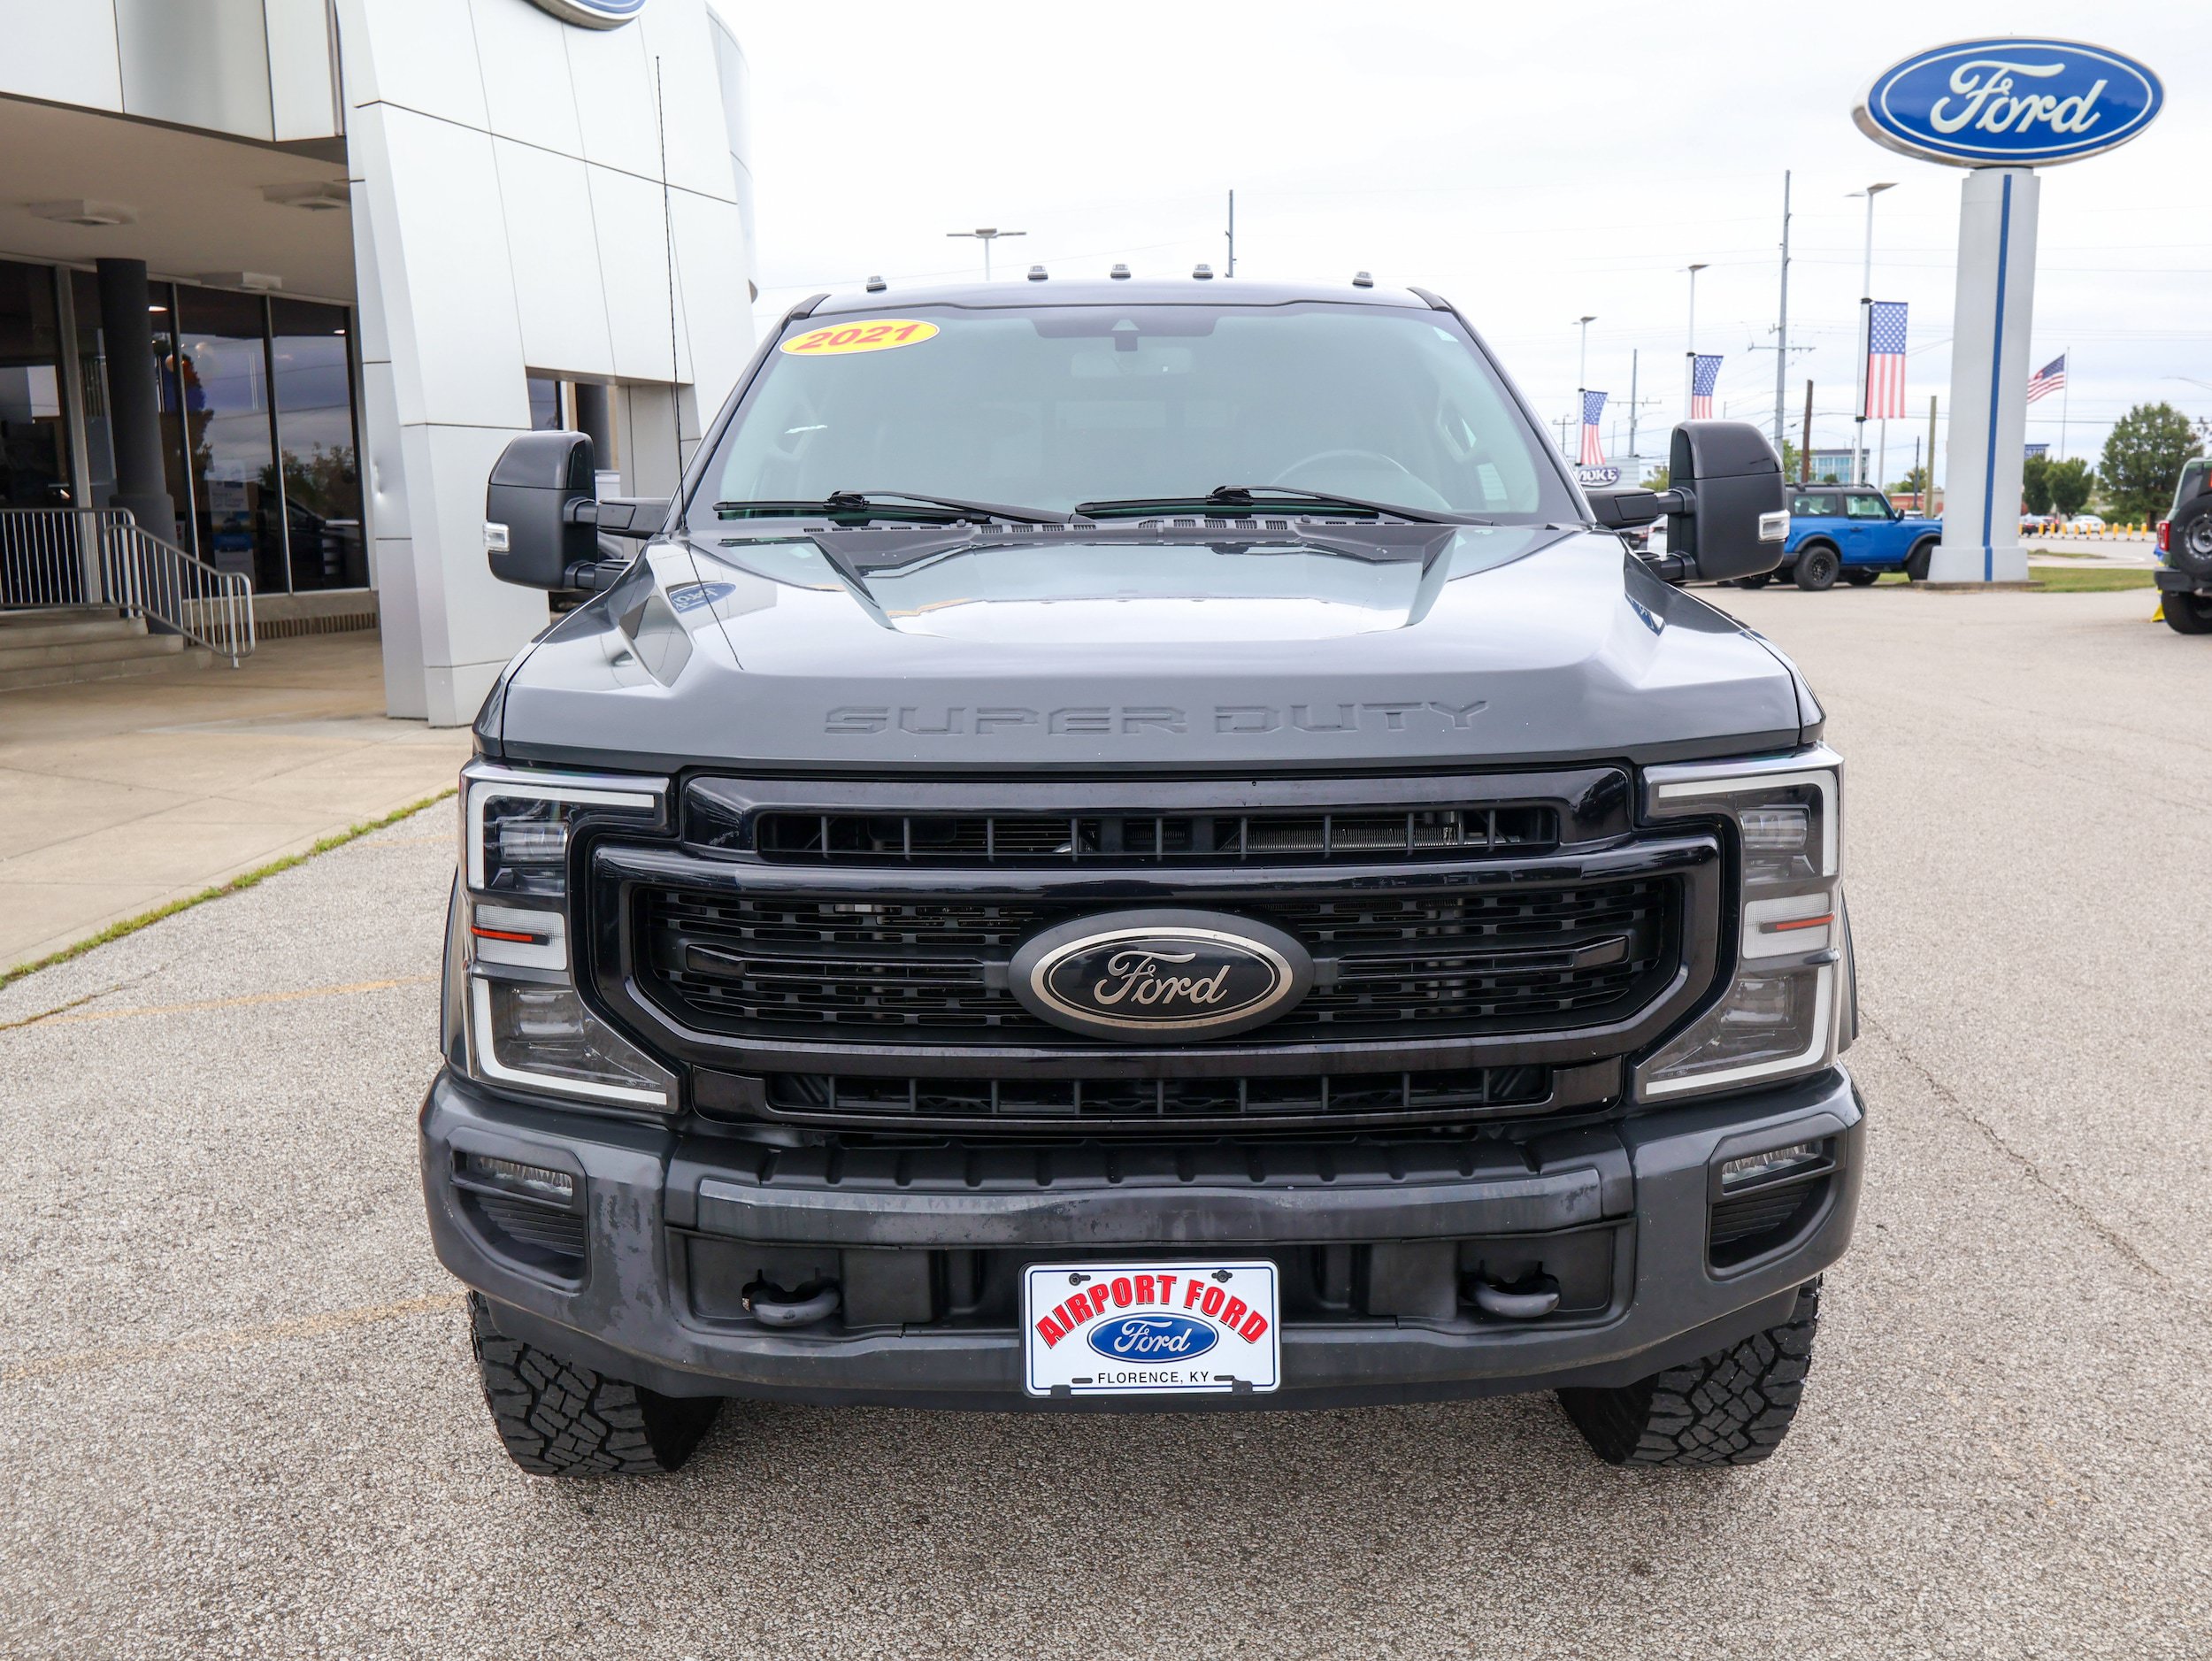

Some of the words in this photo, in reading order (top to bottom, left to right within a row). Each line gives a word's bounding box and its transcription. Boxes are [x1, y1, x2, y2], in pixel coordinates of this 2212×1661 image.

[1929, 59, 2108, 134] Ford
[794, 324, 921, 351] 2021
[824, 707, 1188, 735] SUPER
[1214, 700, 1488, 734] DUTY
[1093, 950, 1232, 1005] Ford
[1034, 1273, 1178, 1350] AIRPORT
[1183, 1279, 1269, 1344] FORD
[1113, 1319, 1191, 1353] Ford
[1098, 1372, 1184, 1385] FLORENCE,
[1189, 1371, 1210, 1383] KY
